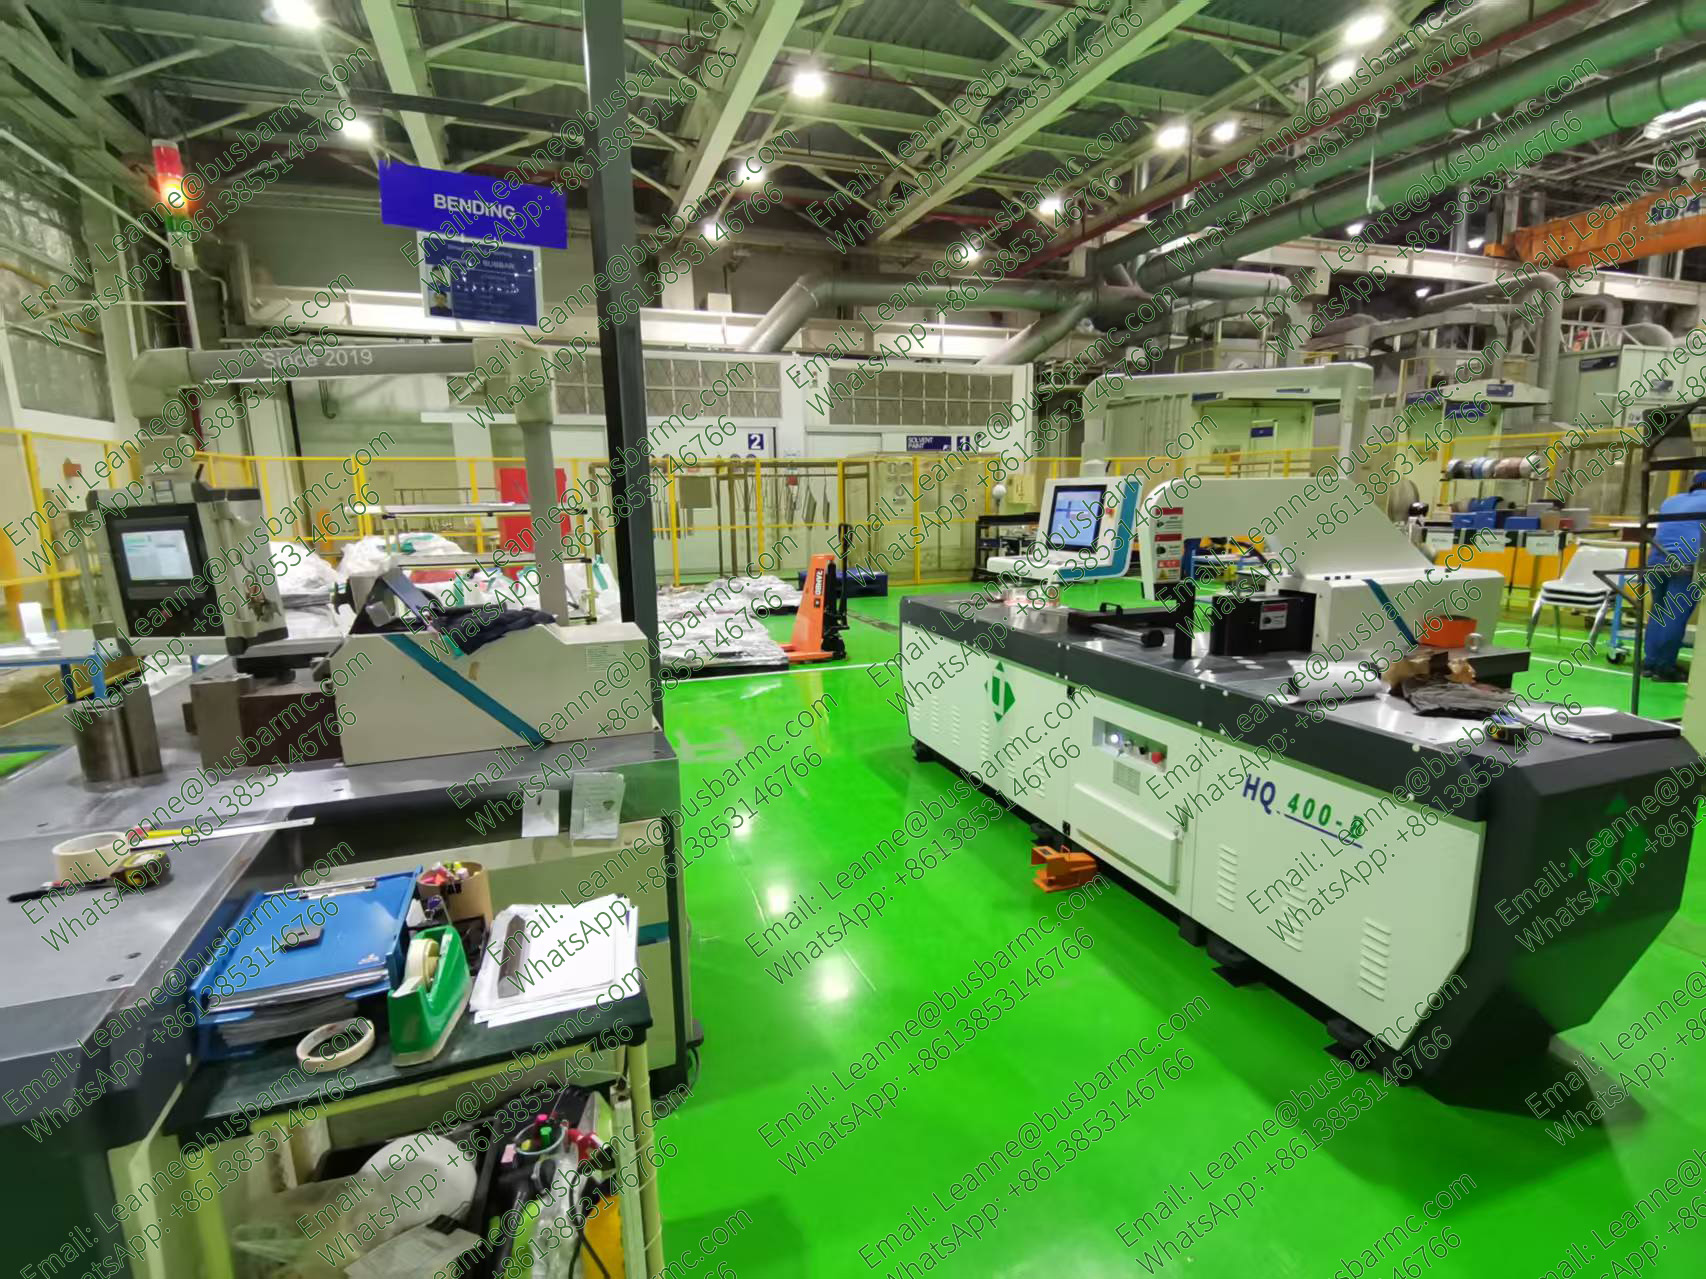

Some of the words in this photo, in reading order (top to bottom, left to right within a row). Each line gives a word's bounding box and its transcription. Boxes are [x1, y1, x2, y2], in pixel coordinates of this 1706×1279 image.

[433, 193, 518, 221] BENDING
[262, 350, 319, 370] Since
[325, 348, 374, 367] 2019
[750, 434, 761, 449] 2
[1242, 773, 1276, 815] HQ
